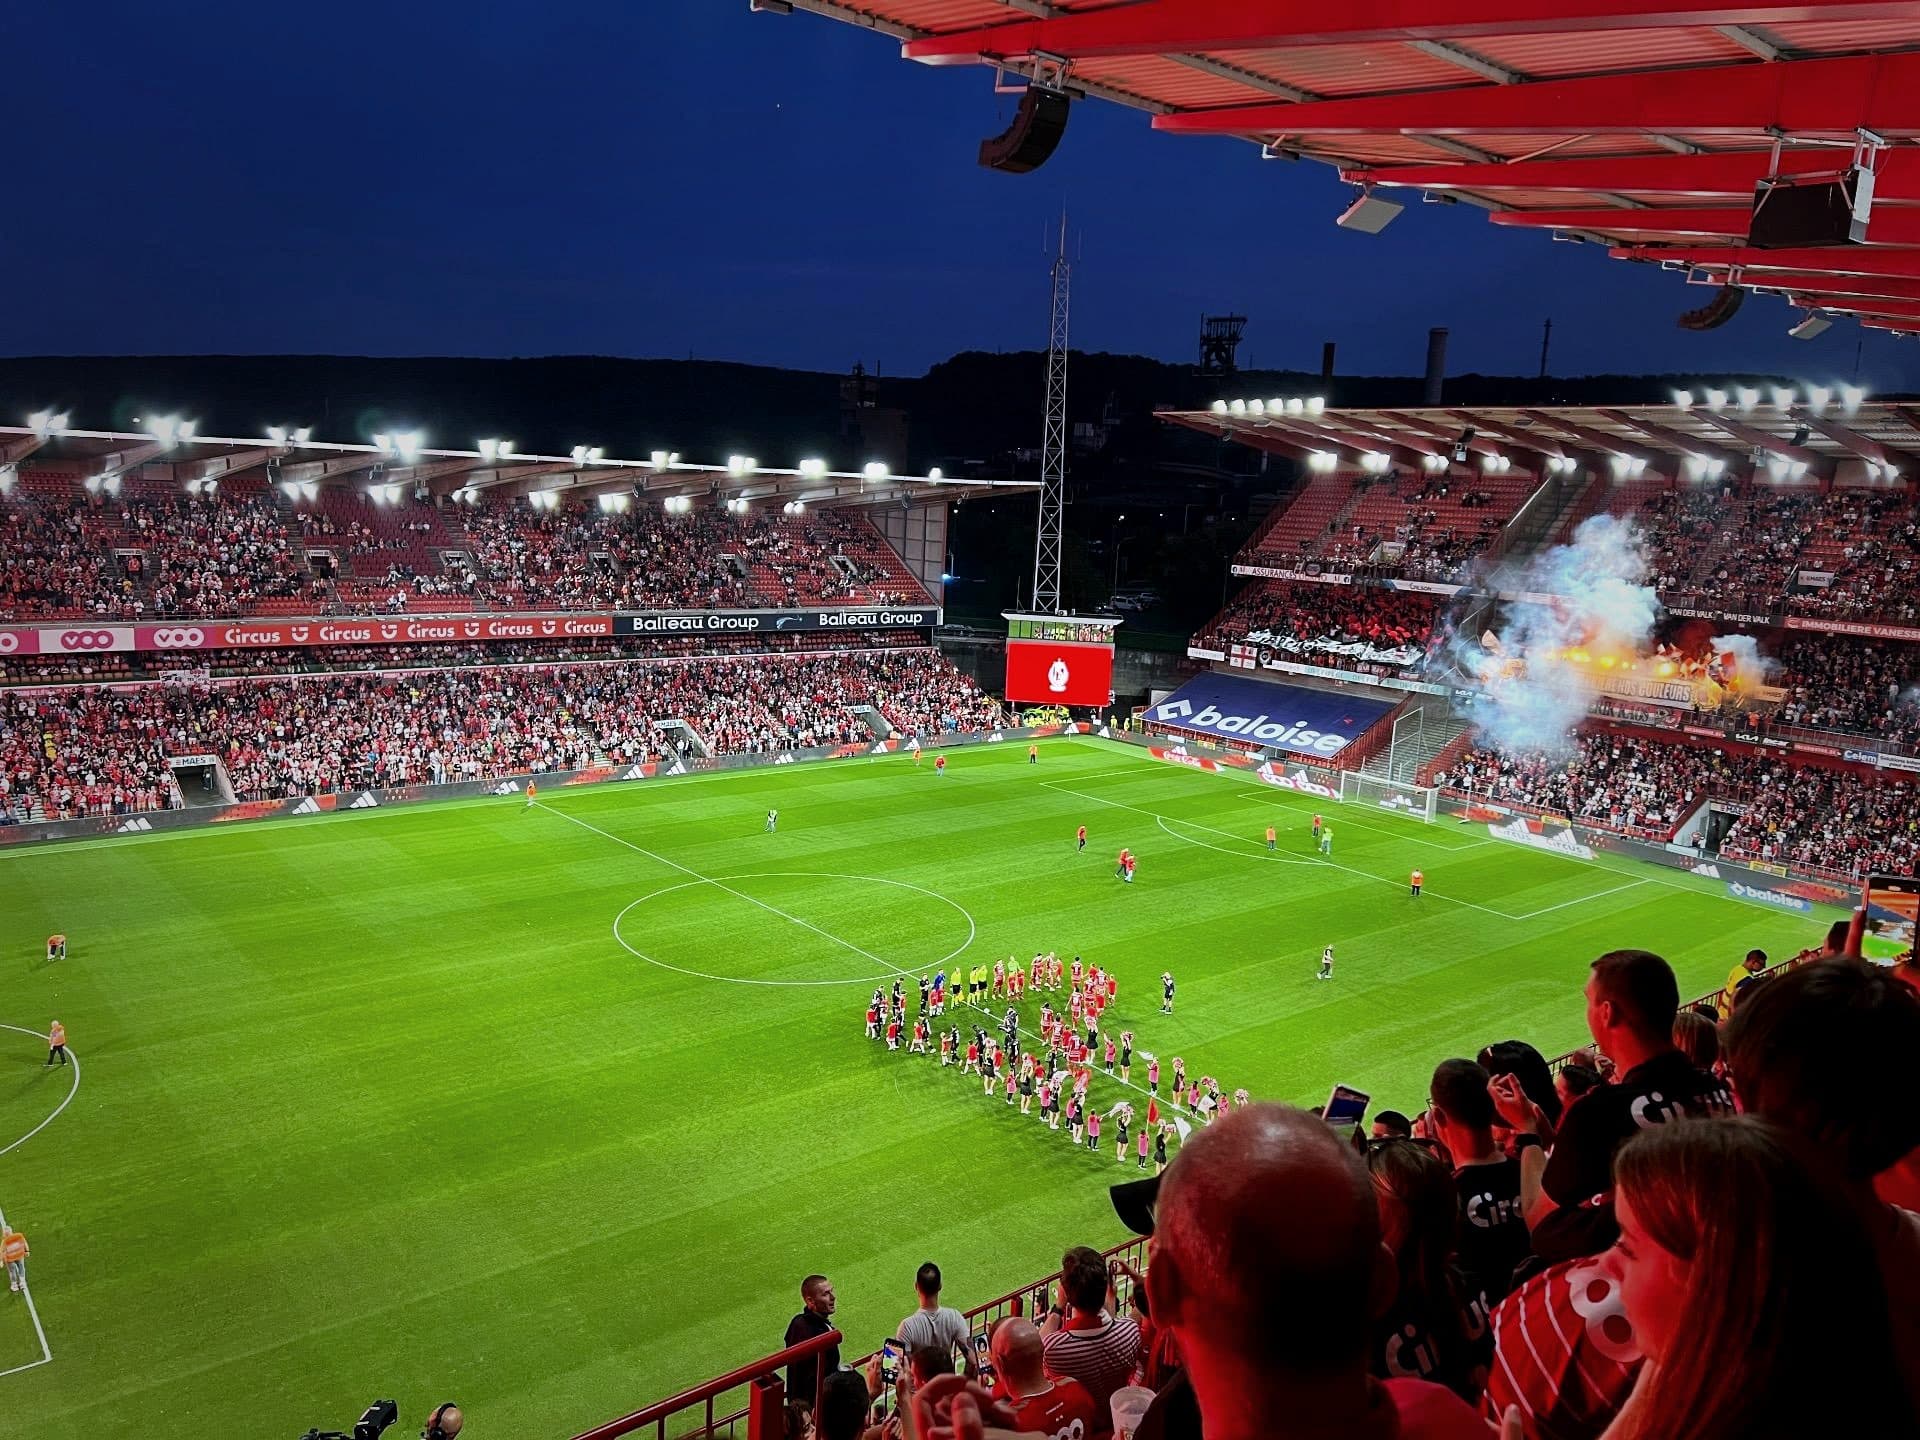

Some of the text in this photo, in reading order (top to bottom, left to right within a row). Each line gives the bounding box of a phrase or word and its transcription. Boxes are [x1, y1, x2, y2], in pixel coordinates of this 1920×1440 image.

[880, 611, 923, 626] Group
[1669, 607, 1714, 619] VAN DER VALK
[1723, 612, 1770, 624] VAN DER VALK
[407, 623, 455, 638] Circus
[488, 621, 534, 636] Circus
[565, 620, 606, 634] Circus
[708, 615, 759, 631] Group
[1802, 620, 1873, 634] IMMOBILIERE
[224, 628, 281, 644] Circus
[319, 625, 371, 641] Circus
[1639, 680, 1691, 702] COULEURS
[1188, 705, 1348, 751] baloise
[182, 756, 207, 765] MAES
[1746, 885, 1804, 910] baloise
